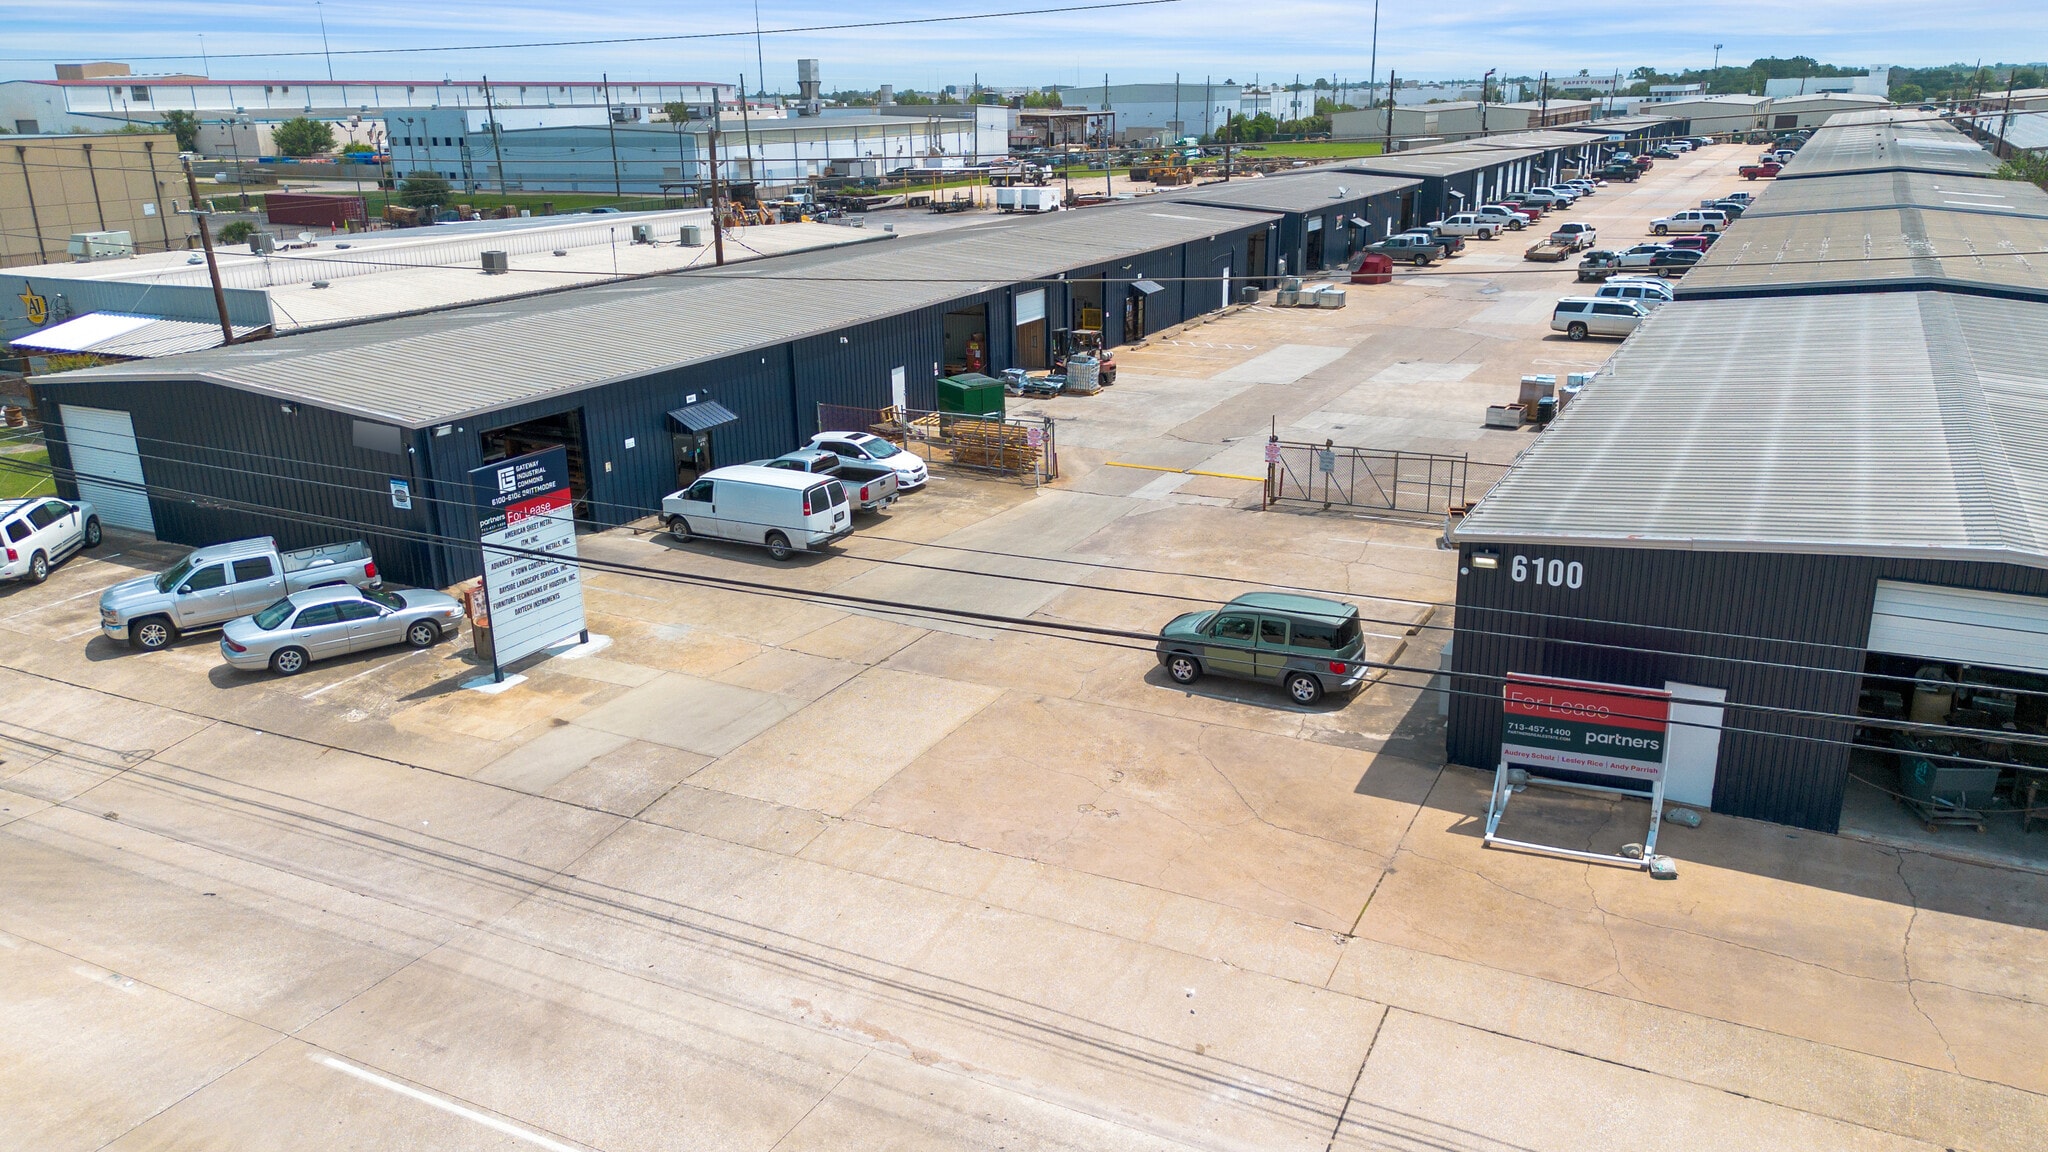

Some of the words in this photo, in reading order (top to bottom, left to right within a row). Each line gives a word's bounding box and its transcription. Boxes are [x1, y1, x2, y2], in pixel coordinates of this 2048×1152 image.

[516, 460, 539, 472] GATEWAY
[516, 467, 546, 480] INDUSTRIAL
[518, 476, 544, 488] COMMONS
[507, 510, 522, 523] For
[524, 502, 550, 518] Lease
[480, 514, 506, 528] partners
[505, 527, 526, 539] AMERICAN
[526, 522, 539, 532] SHEET
[539, 518, 552, 528] METAL
[1512, 555, 1583, 589] 6100
[517, 574, 539, 588] LANDSCAPE
[494, 596, 516, 610] FURNITURE
[1511, 692, 1544, 710] For
[1550, 696, 1610, 719] Lease
[1508, 722, 1571, 737] 713-457-1400
[1585, 731, 1659, 750] partners
[1504, 749, 1529, 758] Audrey
[1562, 756, 1585, 765] Lesley
[1587, 758, 1603, 767] Rice
[1610, 762, 1629, 771] Andy
[1631, 765, 1658, 774] Parrish
